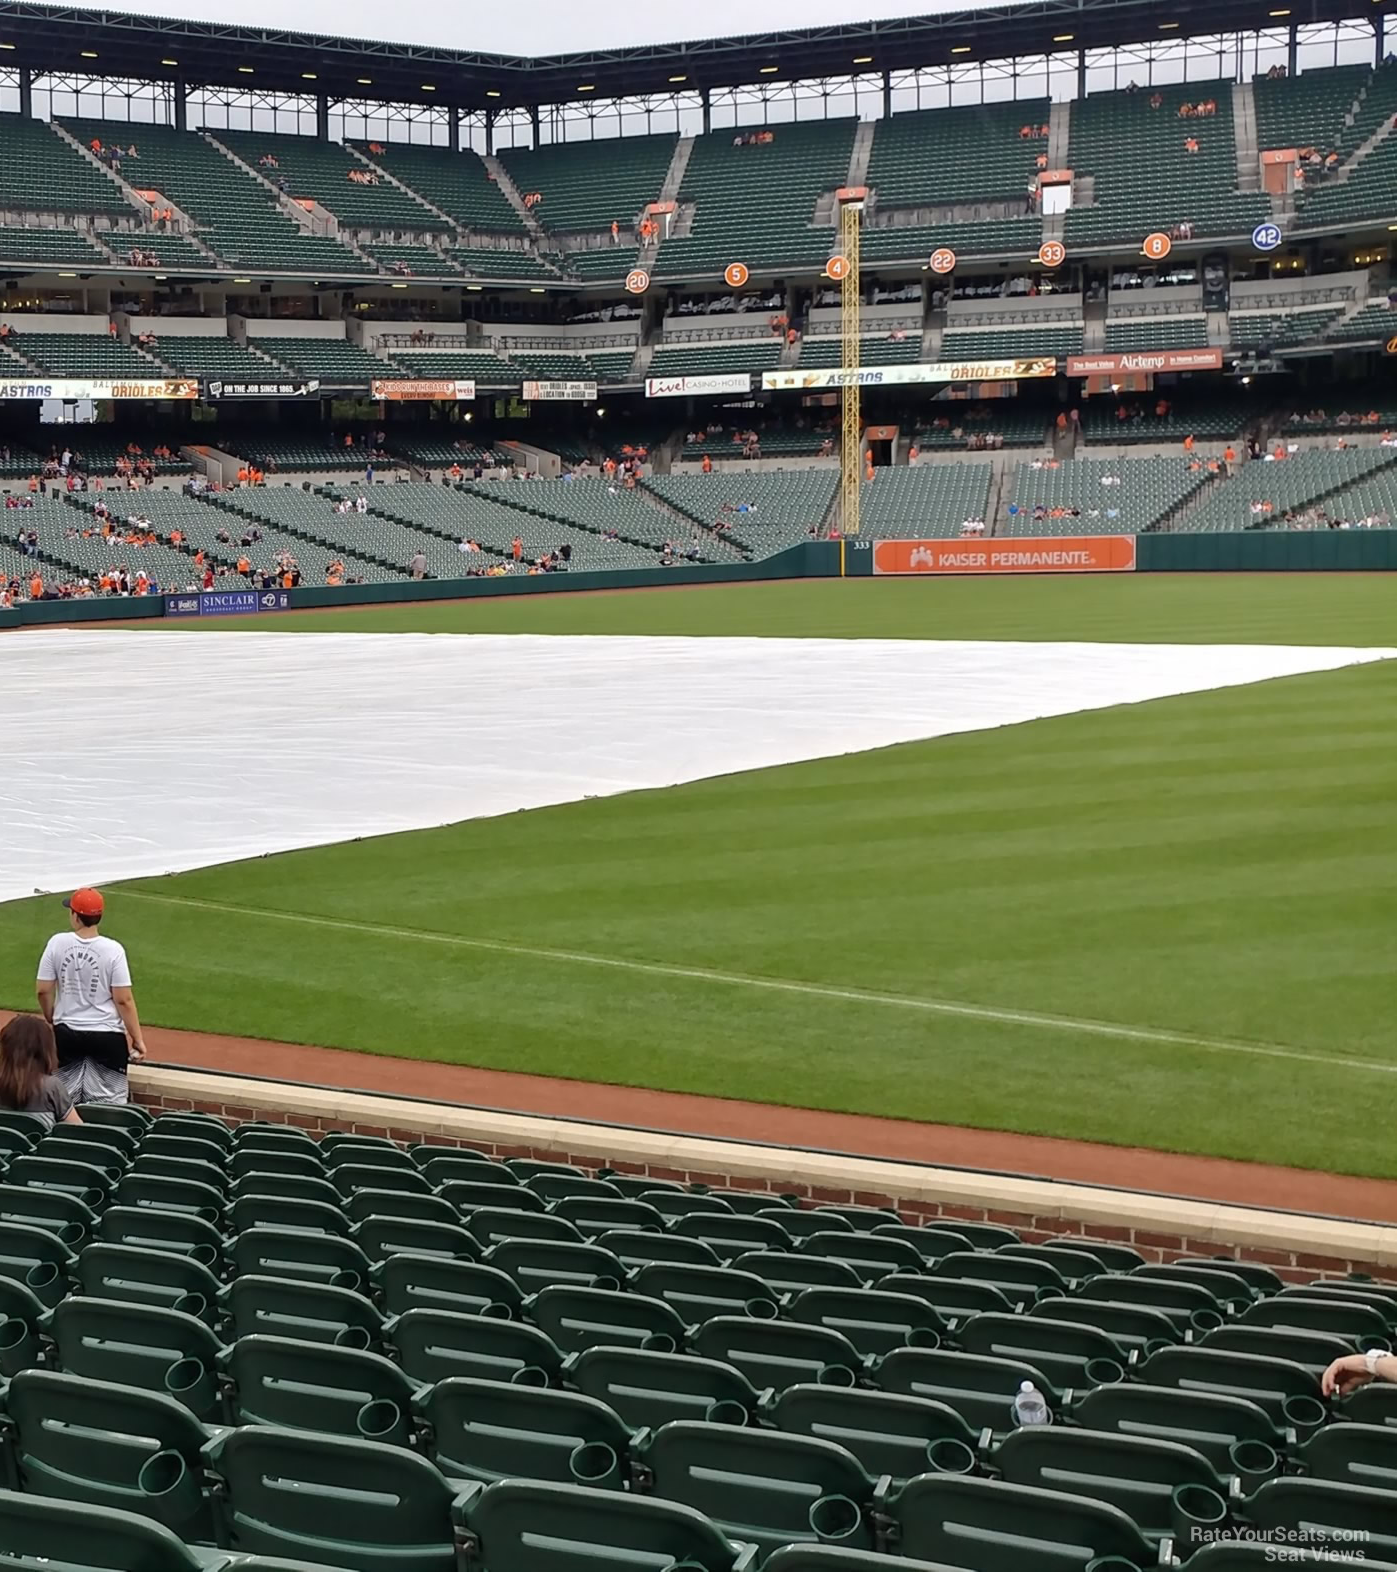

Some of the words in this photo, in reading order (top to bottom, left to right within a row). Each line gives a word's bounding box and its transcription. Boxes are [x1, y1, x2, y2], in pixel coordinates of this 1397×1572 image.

[1257, 230, 1276, 244] 42
[1153, 239, 1161, 252] 8
[1043, 247, 1061, 260] 33
[935, 255, 951, 267] 22
[732, 268, 741, 281] 5
[832, 262, 842, 274] 4
[630, 275, 645, 288] 20
[1120, 355, 1165, 369] Airtemp
[950, 366, 1012, 380] ORIOLES
[0, 385, 53, 397] ASTROS
[111, 386, 163, 397] ORIOLES
[224, 385, 233, 393] ON
[234, 385, 246, 393] THE
[247, 385, 258, 393] JOB
[259, 385, 278, 393] SINCE
[386, 383, 401, 391] KIDS
[402, 383, 415, 392] RUN
[416, 383, 427, 392] THE
[428, 383, 450, 392] BASES
[649, 377, 685, 396] Live!
[686, 381, 717, 389] CASINO
[722, 379, 746, 387] HOTEL
[853, 541, 869, 550] 333
[939, 552, 987, 567] KAISER
[991, 551, 1090, 566] PERMANENTE
[204, 595, 254, 607] SINCLAIR
